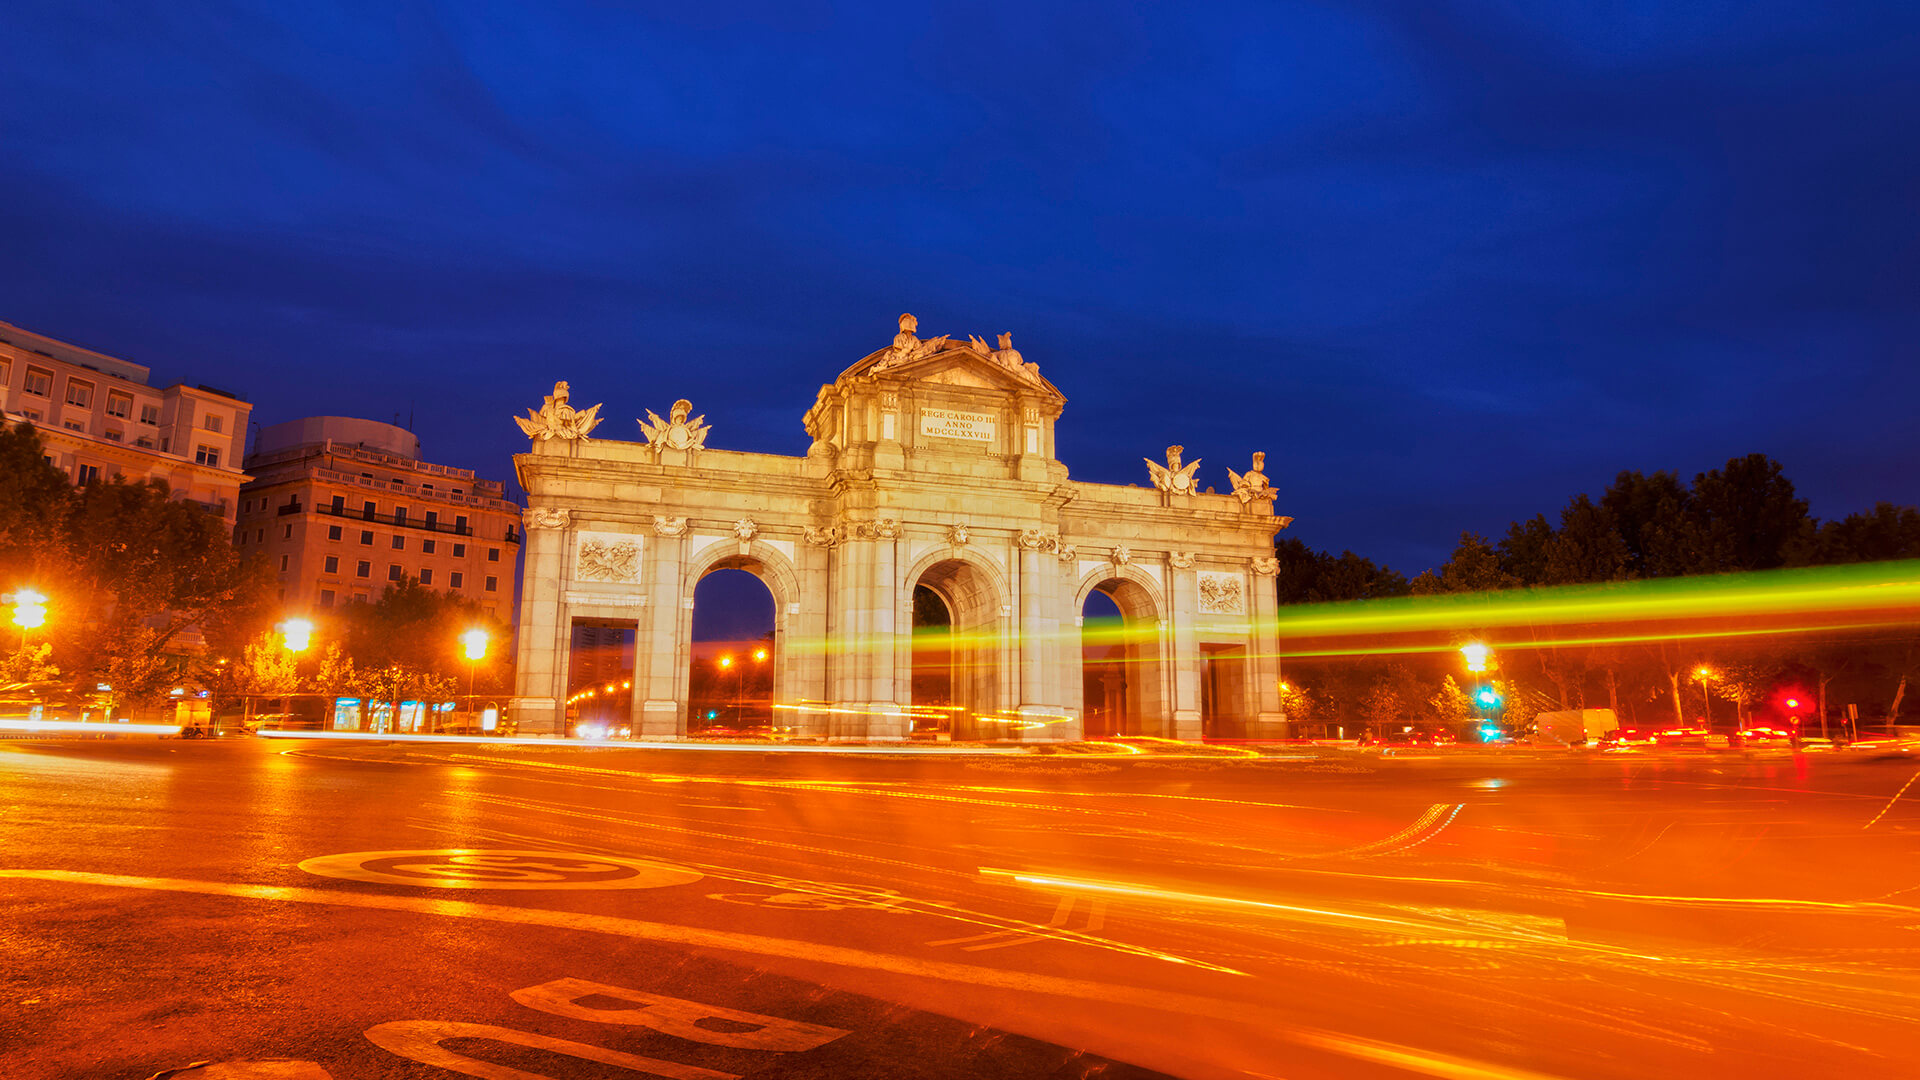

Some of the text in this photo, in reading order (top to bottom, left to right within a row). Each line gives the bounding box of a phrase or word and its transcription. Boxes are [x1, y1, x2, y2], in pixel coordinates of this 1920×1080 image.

[921, 410, 945, 418] REGE
[947, 413, 983, 422] CAROLO
[945, 421, 973, 429] ANNO
[926, 427, 990, 439] MDCCLXXVIII
